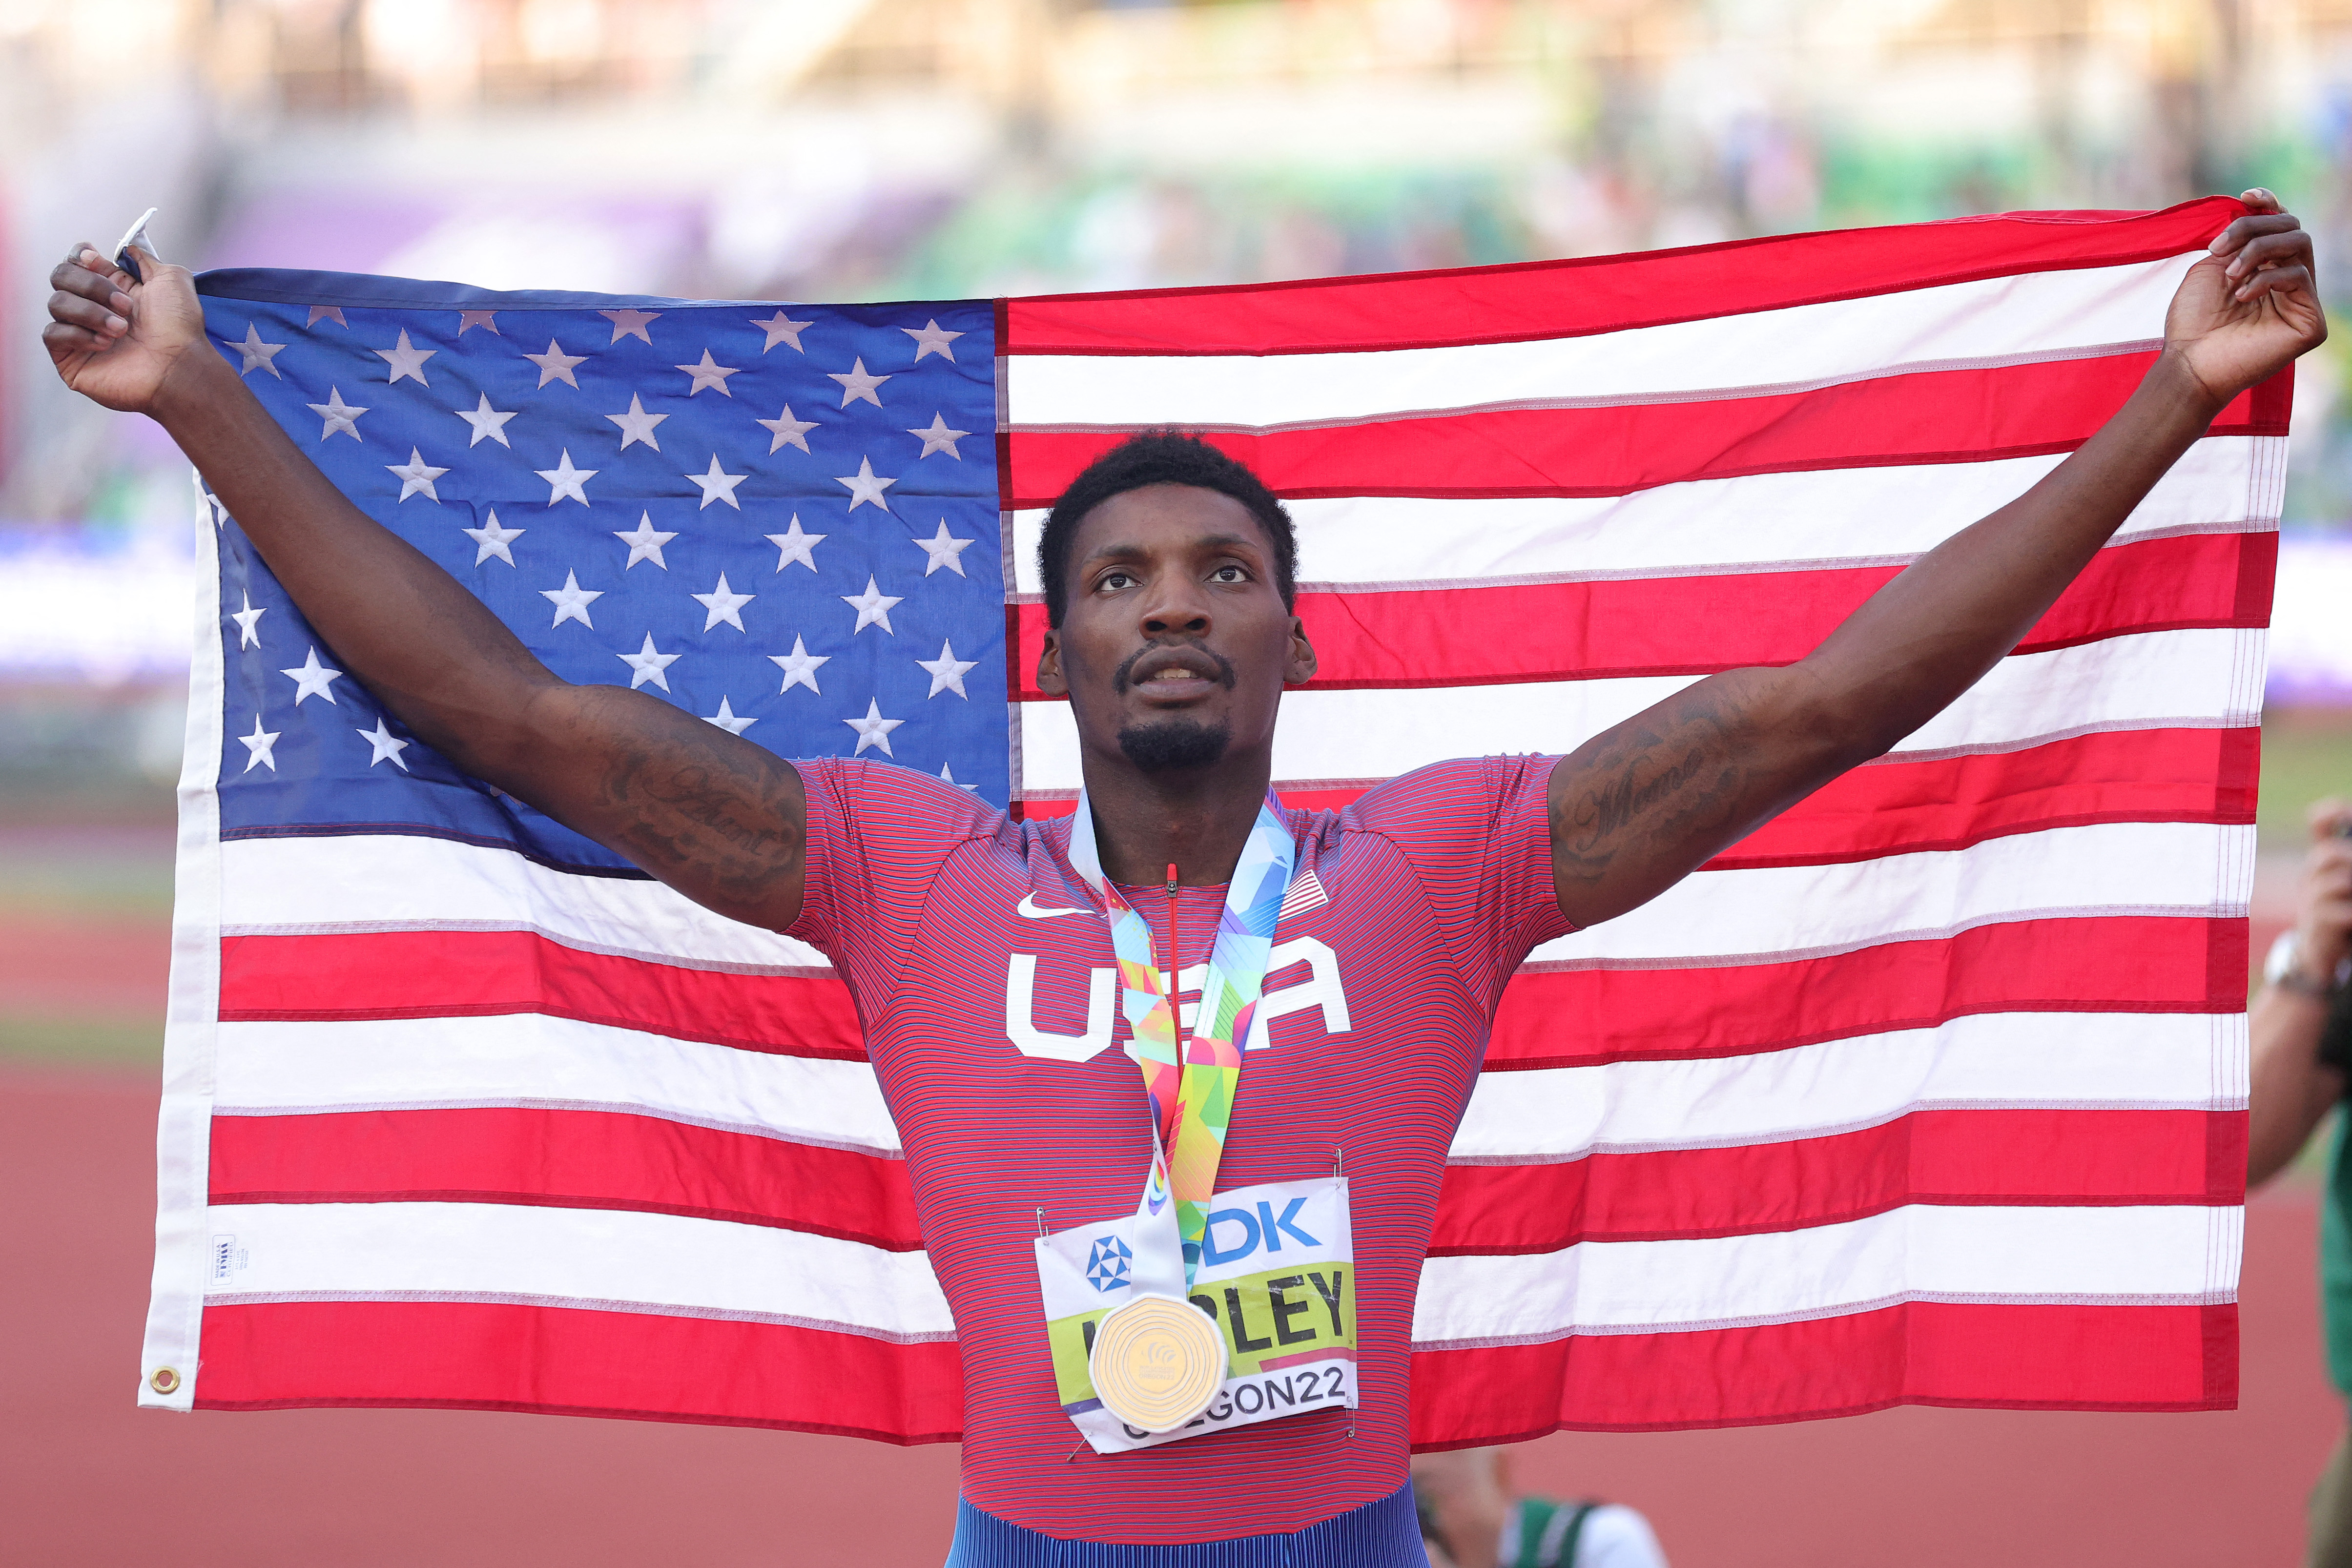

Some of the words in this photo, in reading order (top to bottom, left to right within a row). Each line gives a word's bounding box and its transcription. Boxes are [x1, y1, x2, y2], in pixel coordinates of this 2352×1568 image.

[1006, 936, 1352, 1066] UA
[1202, 1197, 1323, 1267] DK
[1082, 1271, 1343, 1362] LEY
[1122, 1367, 1345, 1440] GON22
